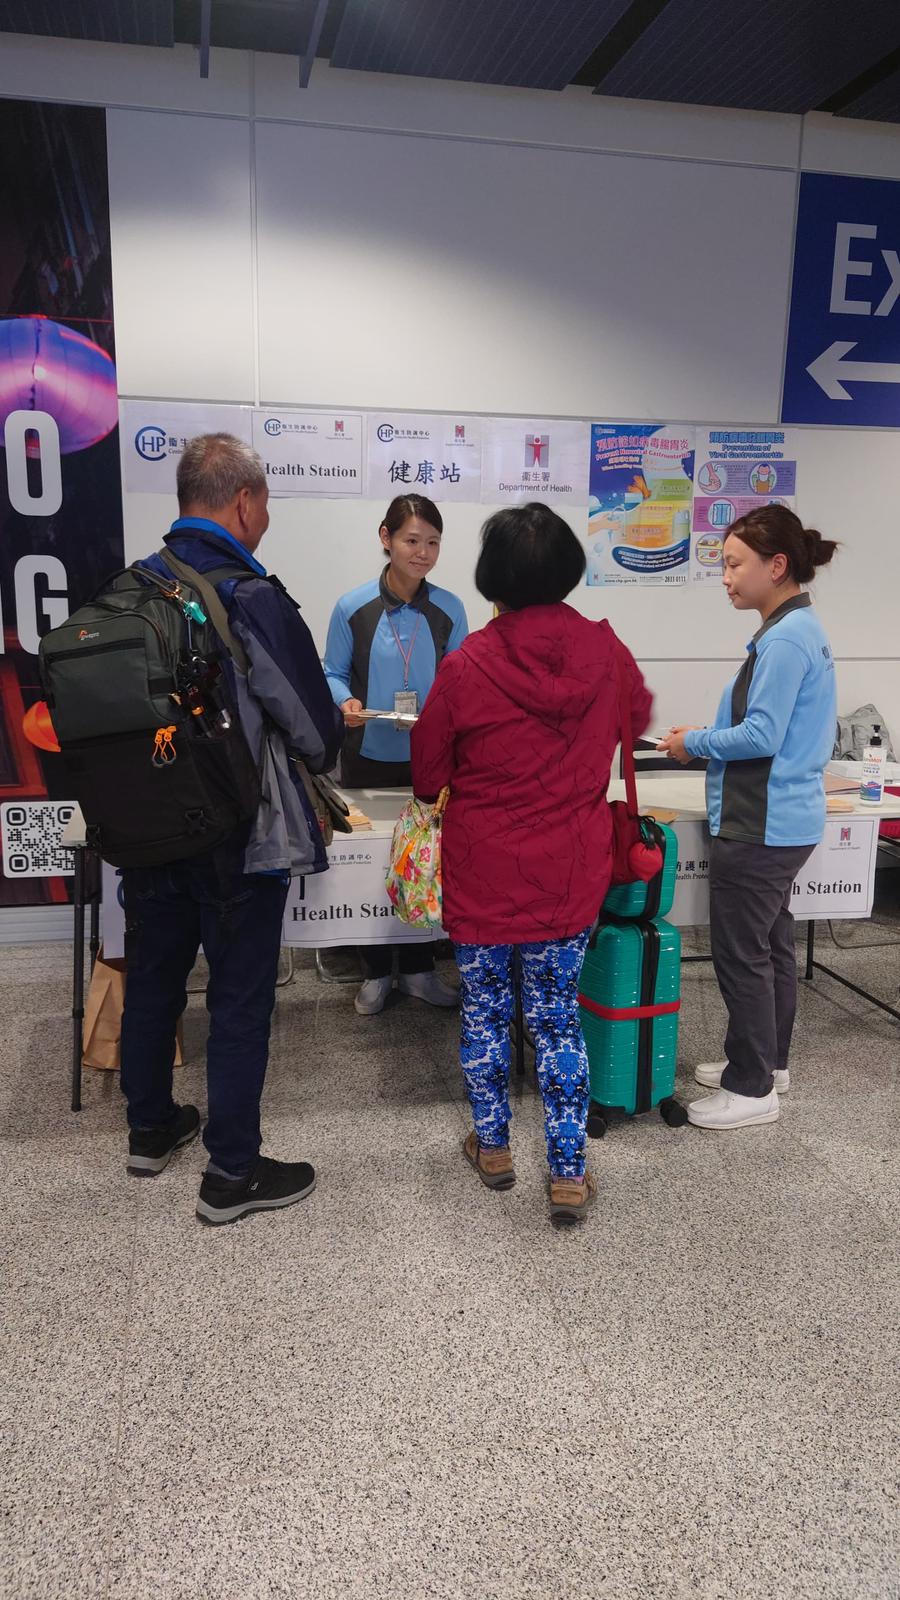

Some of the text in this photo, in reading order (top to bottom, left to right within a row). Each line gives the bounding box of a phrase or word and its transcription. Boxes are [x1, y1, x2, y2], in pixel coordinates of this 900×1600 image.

[309, 465, 357, 478] Station
[388, 460, 461, 485] 健康站
[522, 472, 550, 482] 衛生署
[499, 483, 540, 493] Department
[550, 485, 572, 493] Health
[0, 555, 69, 655] G
[807, 880, 862, 895] Station
[292, 903, 353, 921] Health
